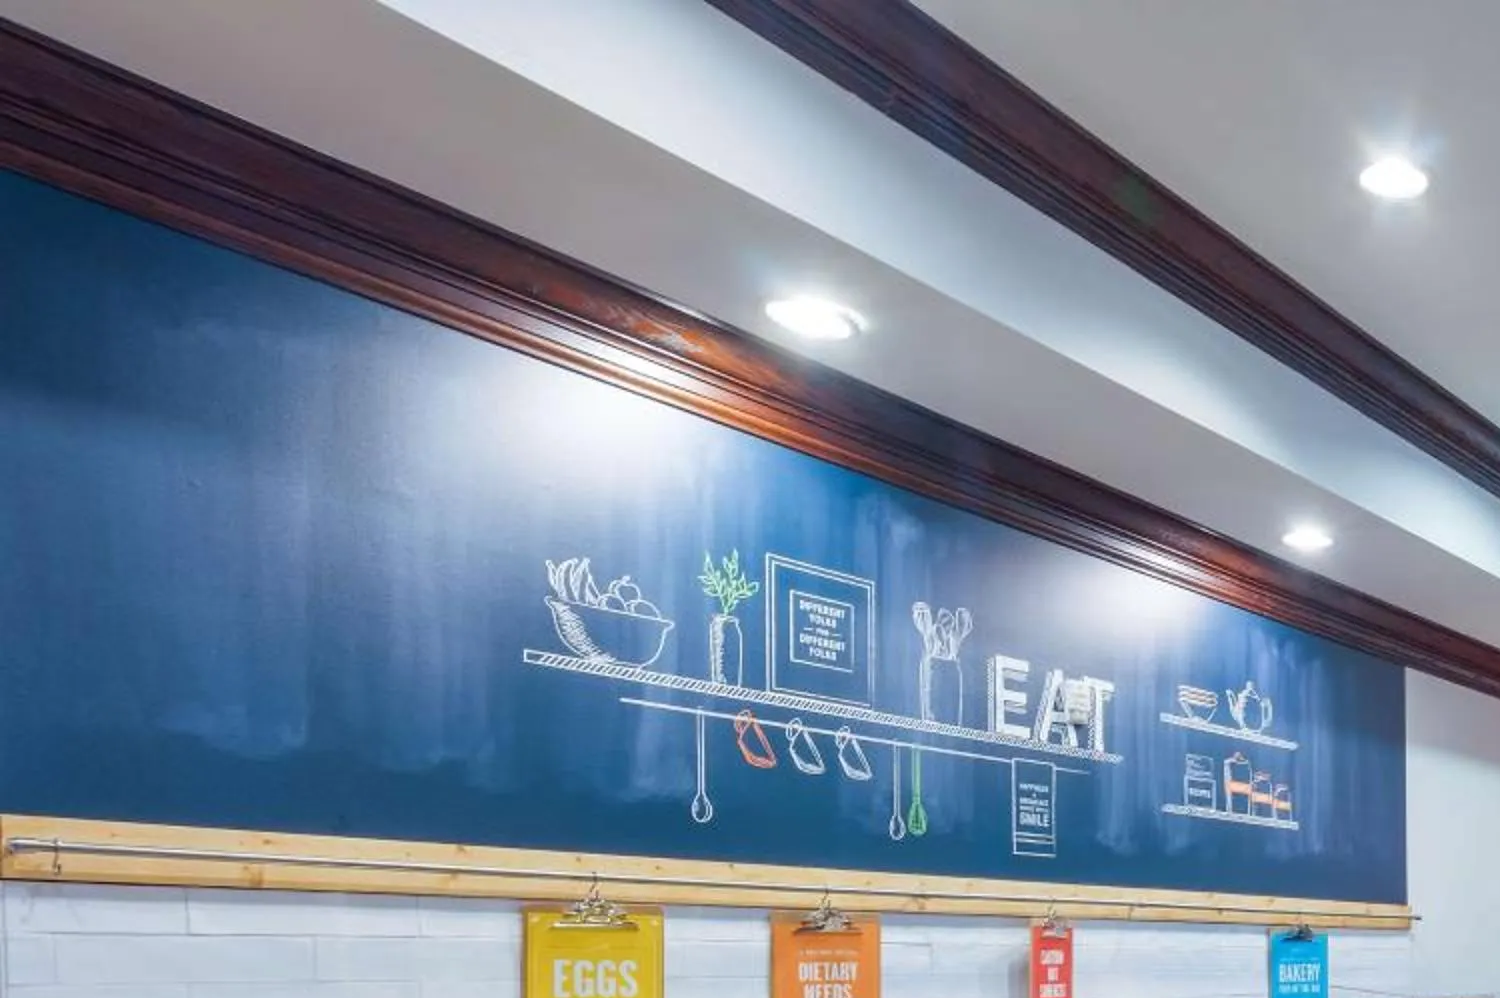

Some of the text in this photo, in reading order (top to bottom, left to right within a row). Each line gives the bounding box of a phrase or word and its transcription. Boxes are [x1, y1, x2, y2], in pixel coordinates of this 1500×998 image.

[799, 633, 845, 652] DIFFERENT
[987, 655, 1115, 753] EAT
[1020, 812, 1050, 828] SMILE
[798, 961, 859, 982] DIETARY
[1279, 963, 1320, 983] BAKERY
